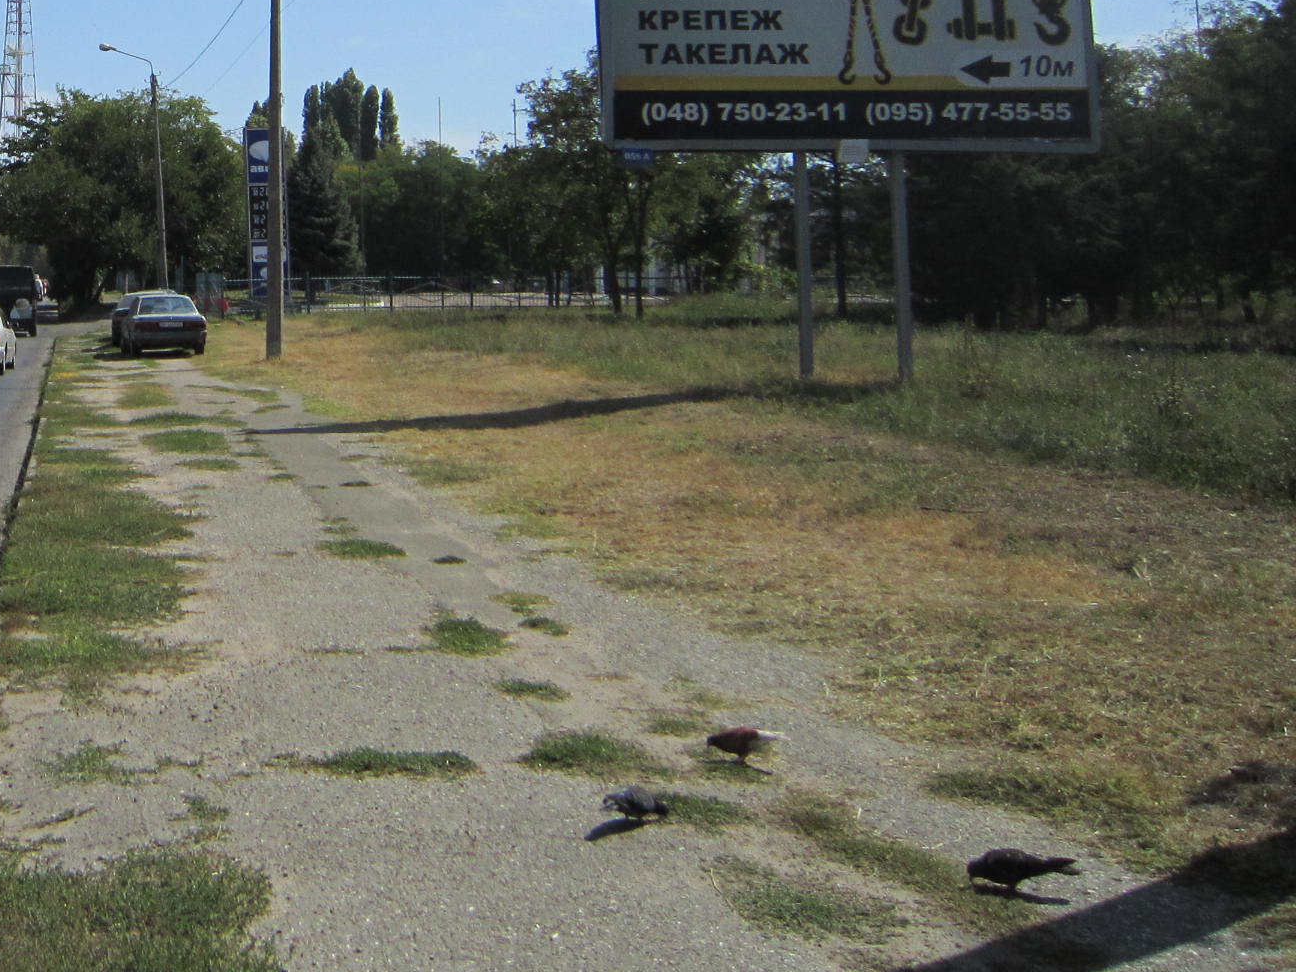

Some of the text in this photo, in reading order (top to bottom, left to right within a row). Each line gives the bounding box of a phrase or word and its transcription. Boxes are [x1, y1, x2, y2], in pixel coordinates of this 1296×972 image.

[638, 10, 784, 31] КРЕПЕЖ
[638, 43, 810, 65] ТАКЕЛАЖ
[641, 102, 847, 126] (048) 750-23-11
[865, 102, 1072, 126] (095) 477-55-55
